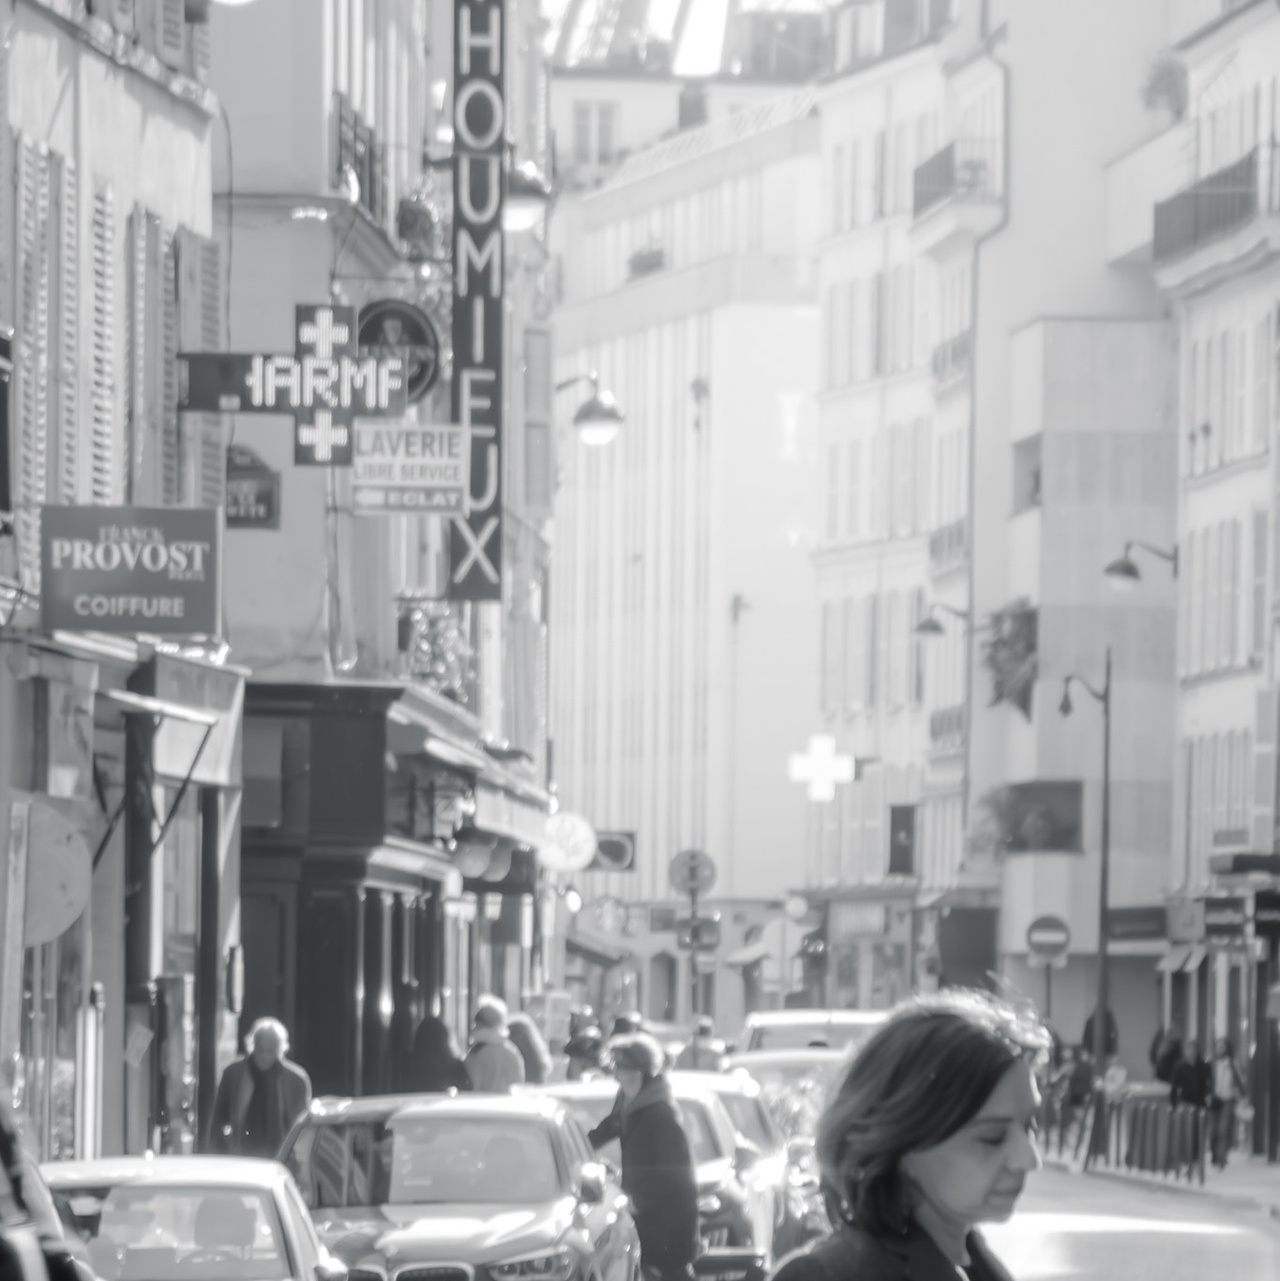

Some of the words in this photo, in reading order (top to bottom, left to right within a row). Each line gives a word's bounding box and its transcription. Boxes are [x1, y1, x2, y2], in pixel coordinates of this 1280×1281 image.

[356, 430, 461, 458] LAVERIE
[401, 463, 460, 482] SERVICE
[51, 538, 210, 572] PROVOST
[73, 594, 184, 618] COIFFURE
